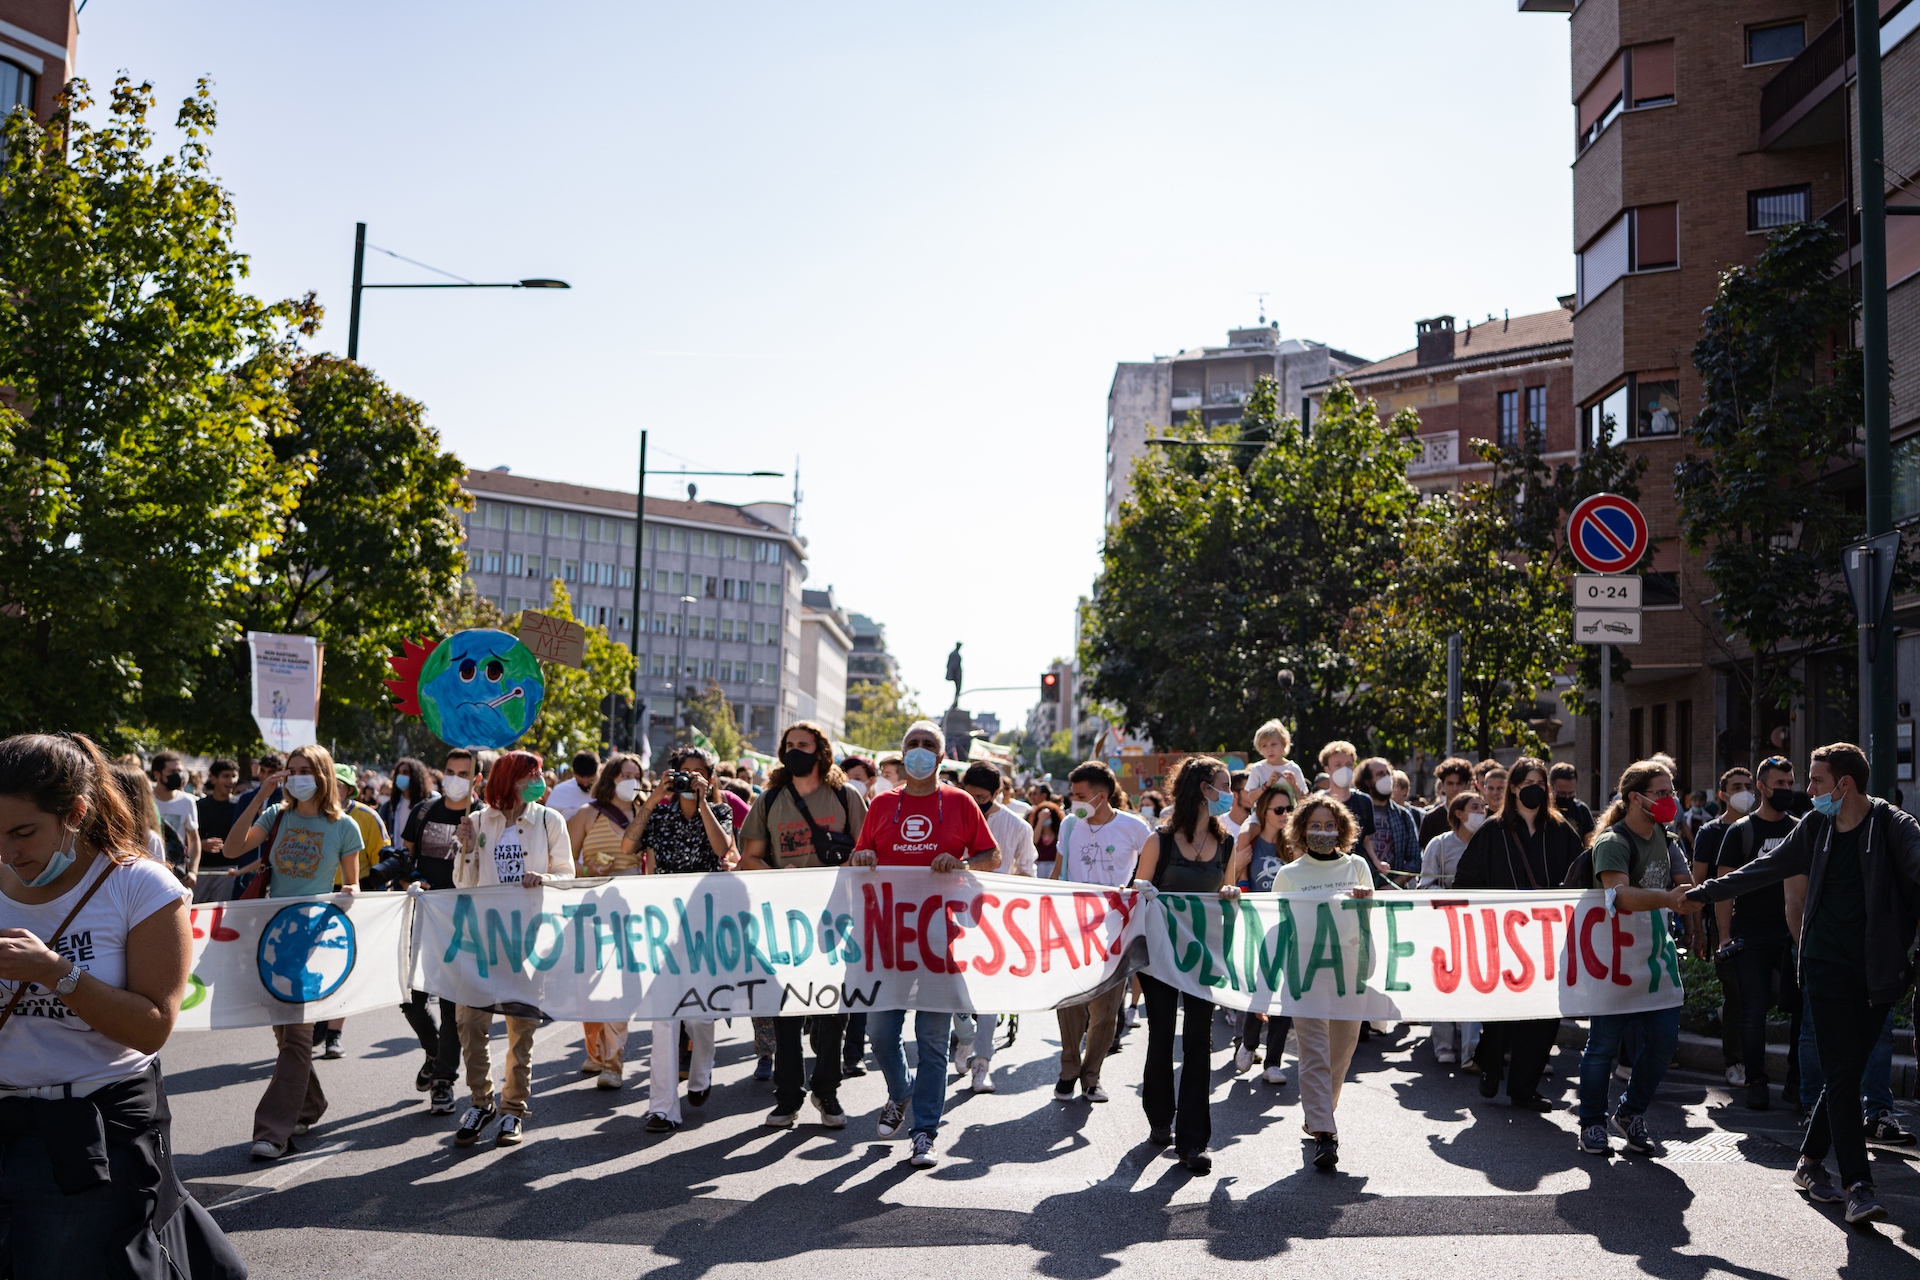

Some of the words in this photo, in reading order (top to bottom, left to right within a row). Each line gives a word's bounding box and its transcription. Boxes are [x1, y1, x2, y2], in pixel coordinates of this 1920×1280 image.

[1588, 586, 1628, 599] 0-24
[525, 613, 576, 639] SAVE
[536, 634, 568, 657] ME
[892, 843, 938, 852] EMERGENCY
[443, 894, 680, 978] ANOTHER
[673, 892, 814, 976] WORLD
[861, 882, 1139, 977] NECESSARY
[1156, 894, 1415, 1000] CLIMATE
[1430, 899, 1634, 994] JUSTICE
[672, 979, 767, 1017] ACT
[780, 980, 882, 1011] NOW
